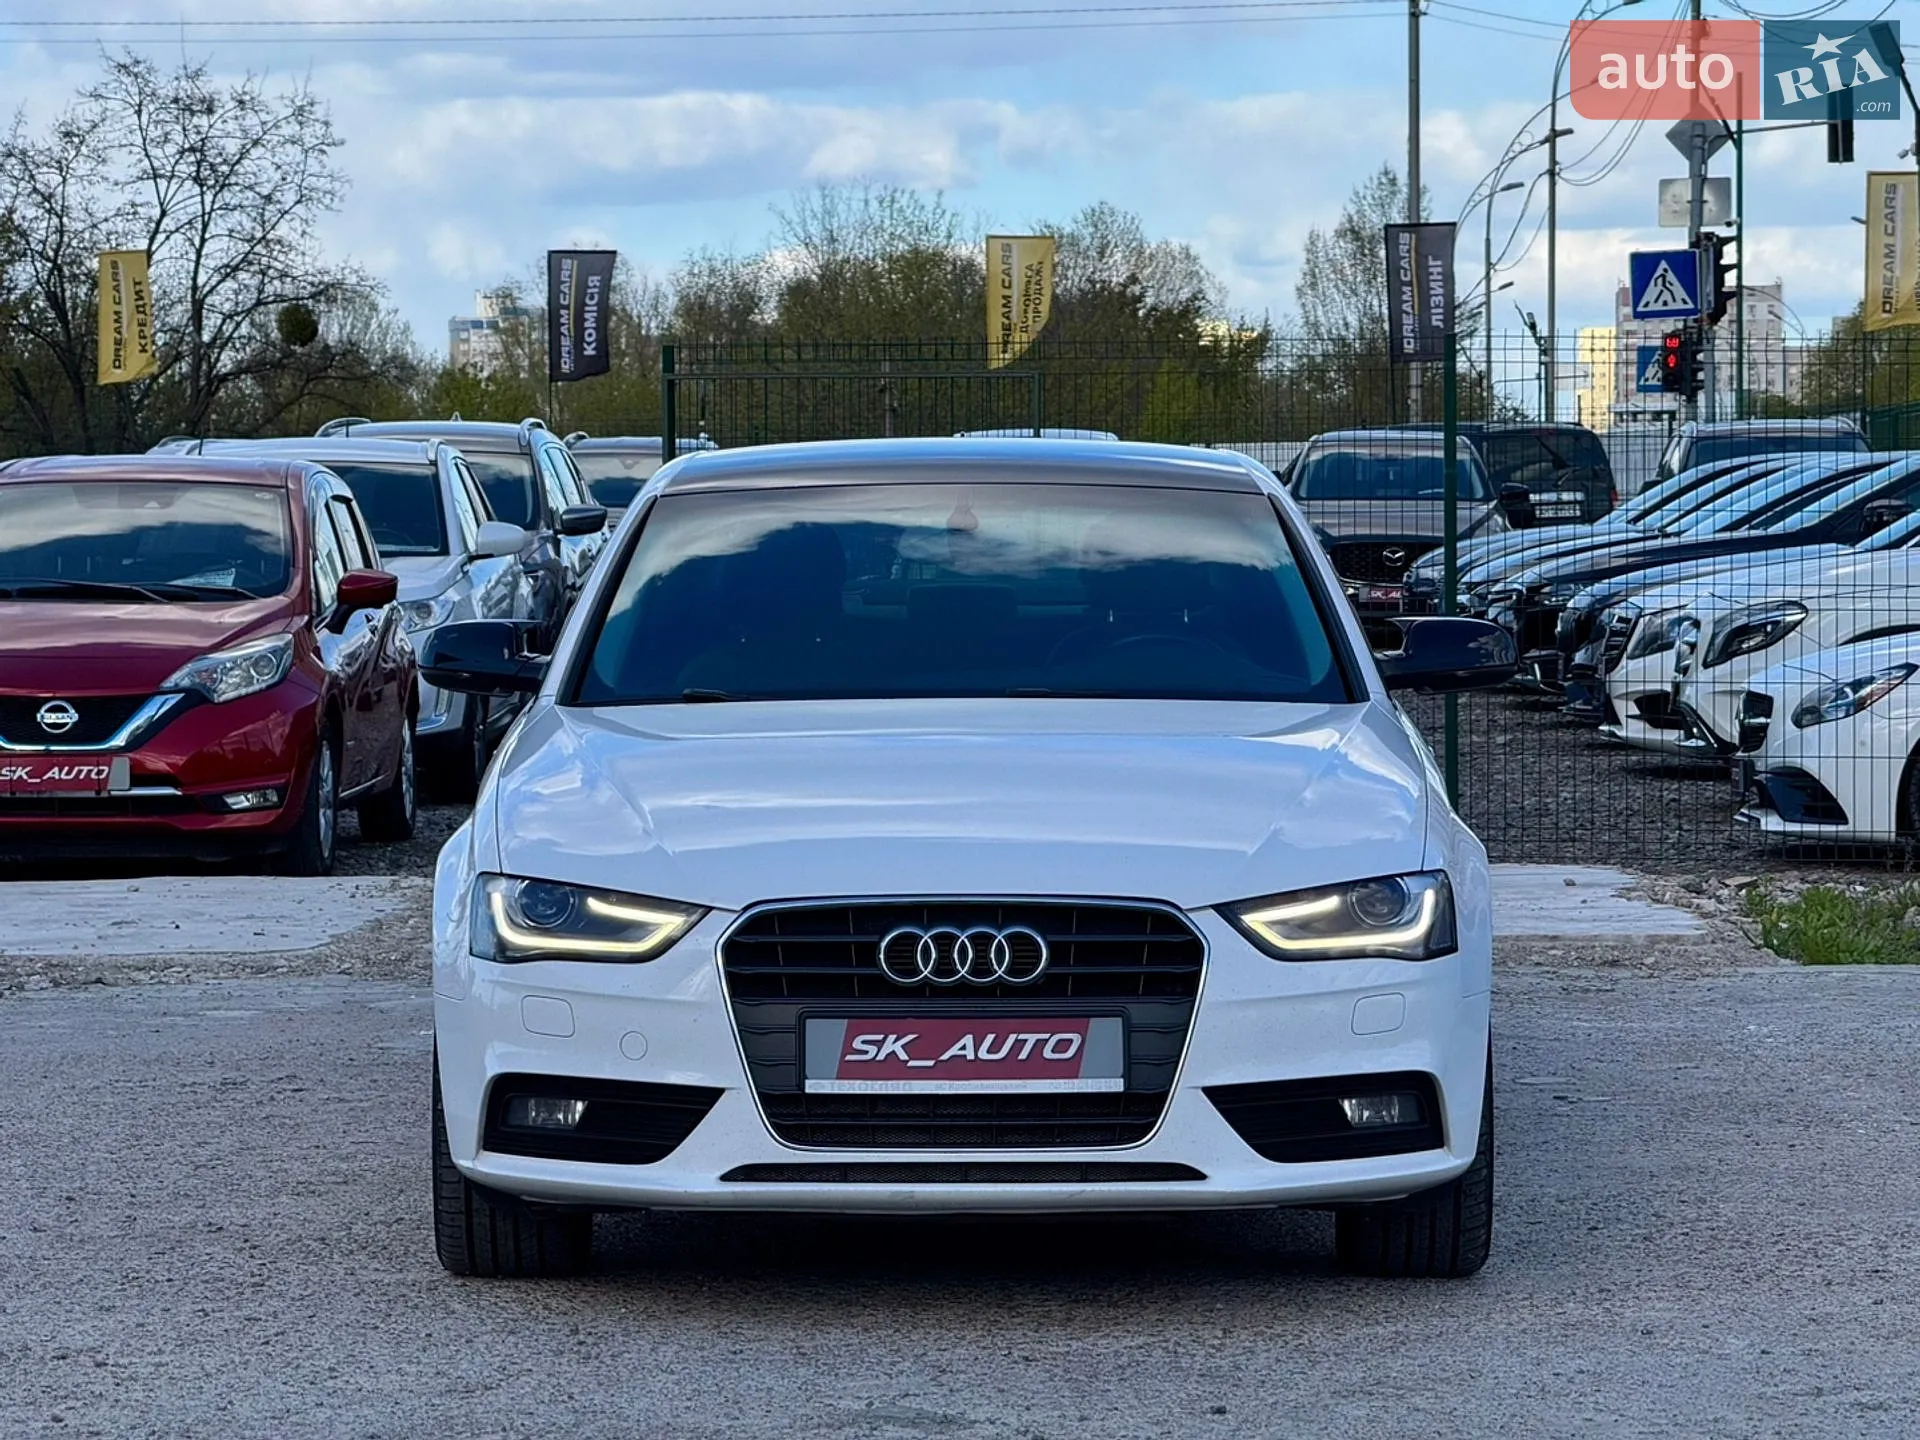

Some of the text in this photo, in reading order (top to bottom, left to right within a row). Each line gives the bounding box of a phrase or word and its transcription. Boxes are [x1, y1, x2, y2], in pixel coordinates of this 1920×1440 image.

[1001, 242, 1012, 290] CARS
[1399, 232, 1411, 281] CARS
[1882, 183, 1897, 314] DREAM CARS
[560, 258, 572, 306] CARS
[1428, 255, 1444, 328] ЛІЗИНГ
[110, 260, 123, 370] DREAM CARS
[132, 277, 149, 354] КРЕДИТ
[583, 275, 601, 356] КОМІСІЯ
[0, 766, 109, 783] SK_AUTO
[845, 1033, 1082, 1067] SK_AUTO
